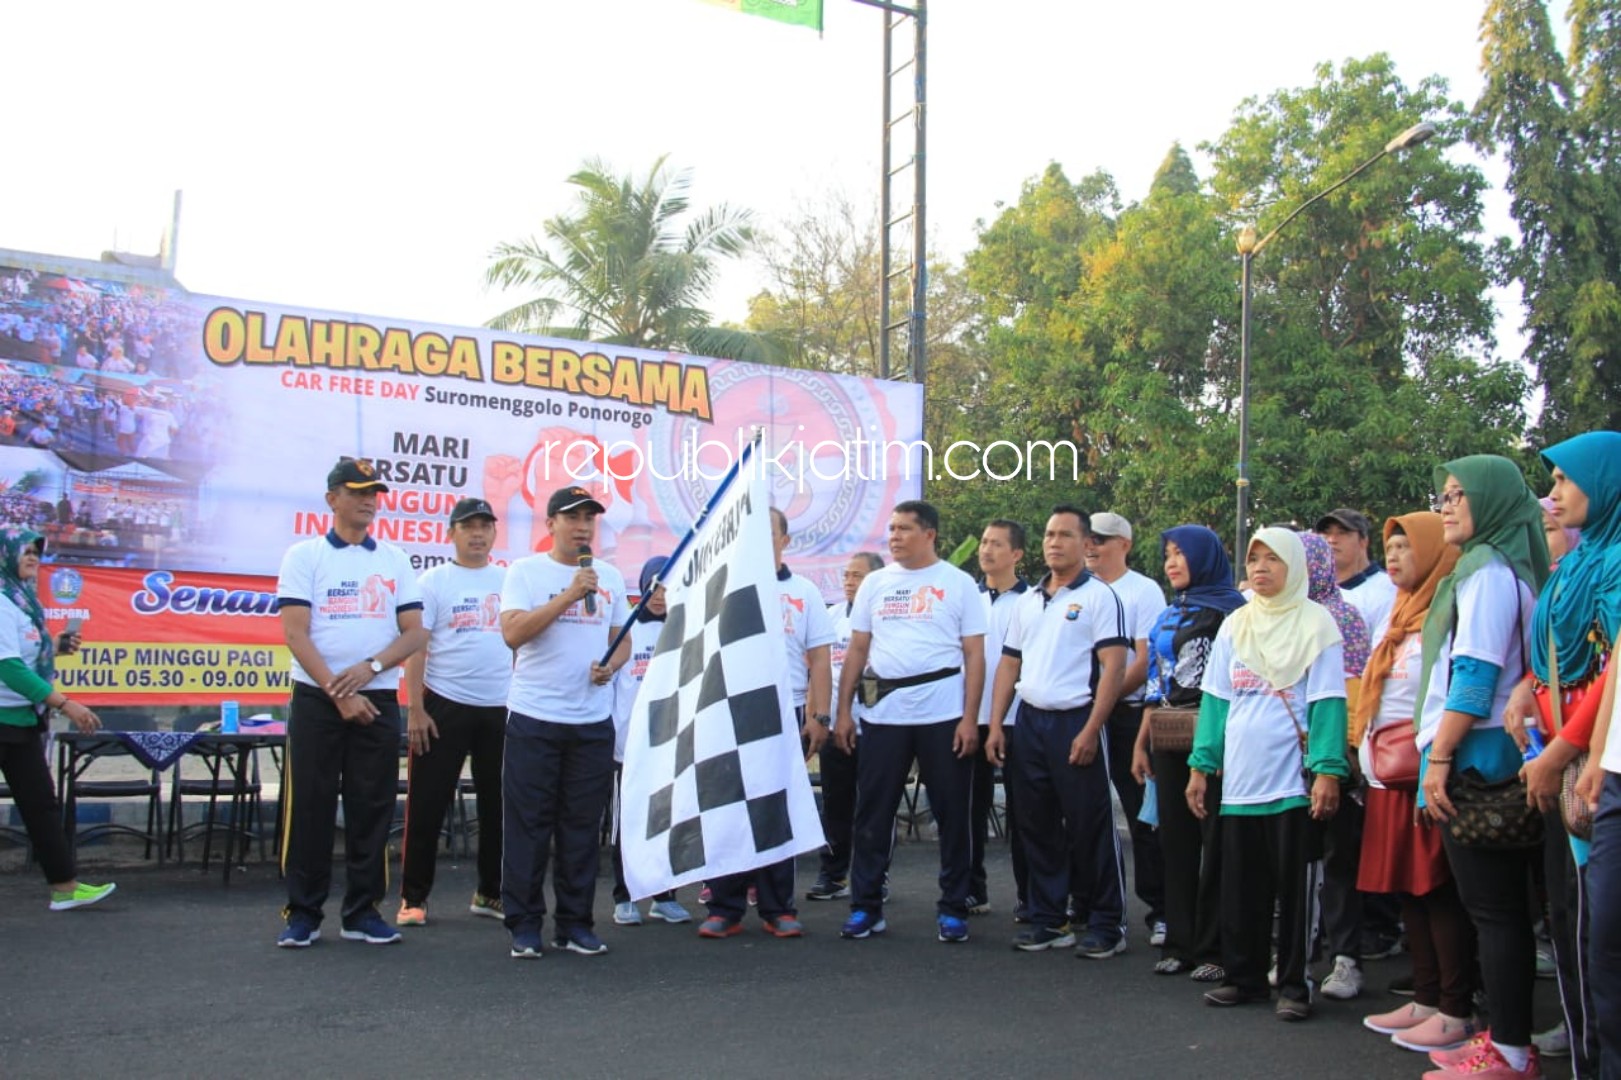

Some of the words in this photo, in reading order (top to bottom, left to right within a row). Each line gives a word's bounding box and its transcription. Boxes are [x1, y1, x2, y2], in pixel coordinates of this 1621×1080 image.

[203, 306, 484, 381] OLAHRAGA
[490, 340, 714, 425] BERSAMA
[281, 370, 323, 391] CAR
[329, 375, 374, 397] FREE
[380, 381, 420, 401] DAY
[425, 385, 562, 417] Suromenggolo
[568, 401, 653, 429] Ponorogo
[393, 432, 469, 459] MARI
[340, 456, 468, 488] RSATU
[376, 489, 466, 516] NGUN
[294, 511, 454, 544] INNESI
[80, 648, 128, 666] TIAP
[135, 649, 220, 667] MINGGU
[227, 651, 273, 667] PAGI
[125, 669, 184, 687] 05.30
[202, 670, 258, 687] 09.00
[265, 670, 290, 687] WI
